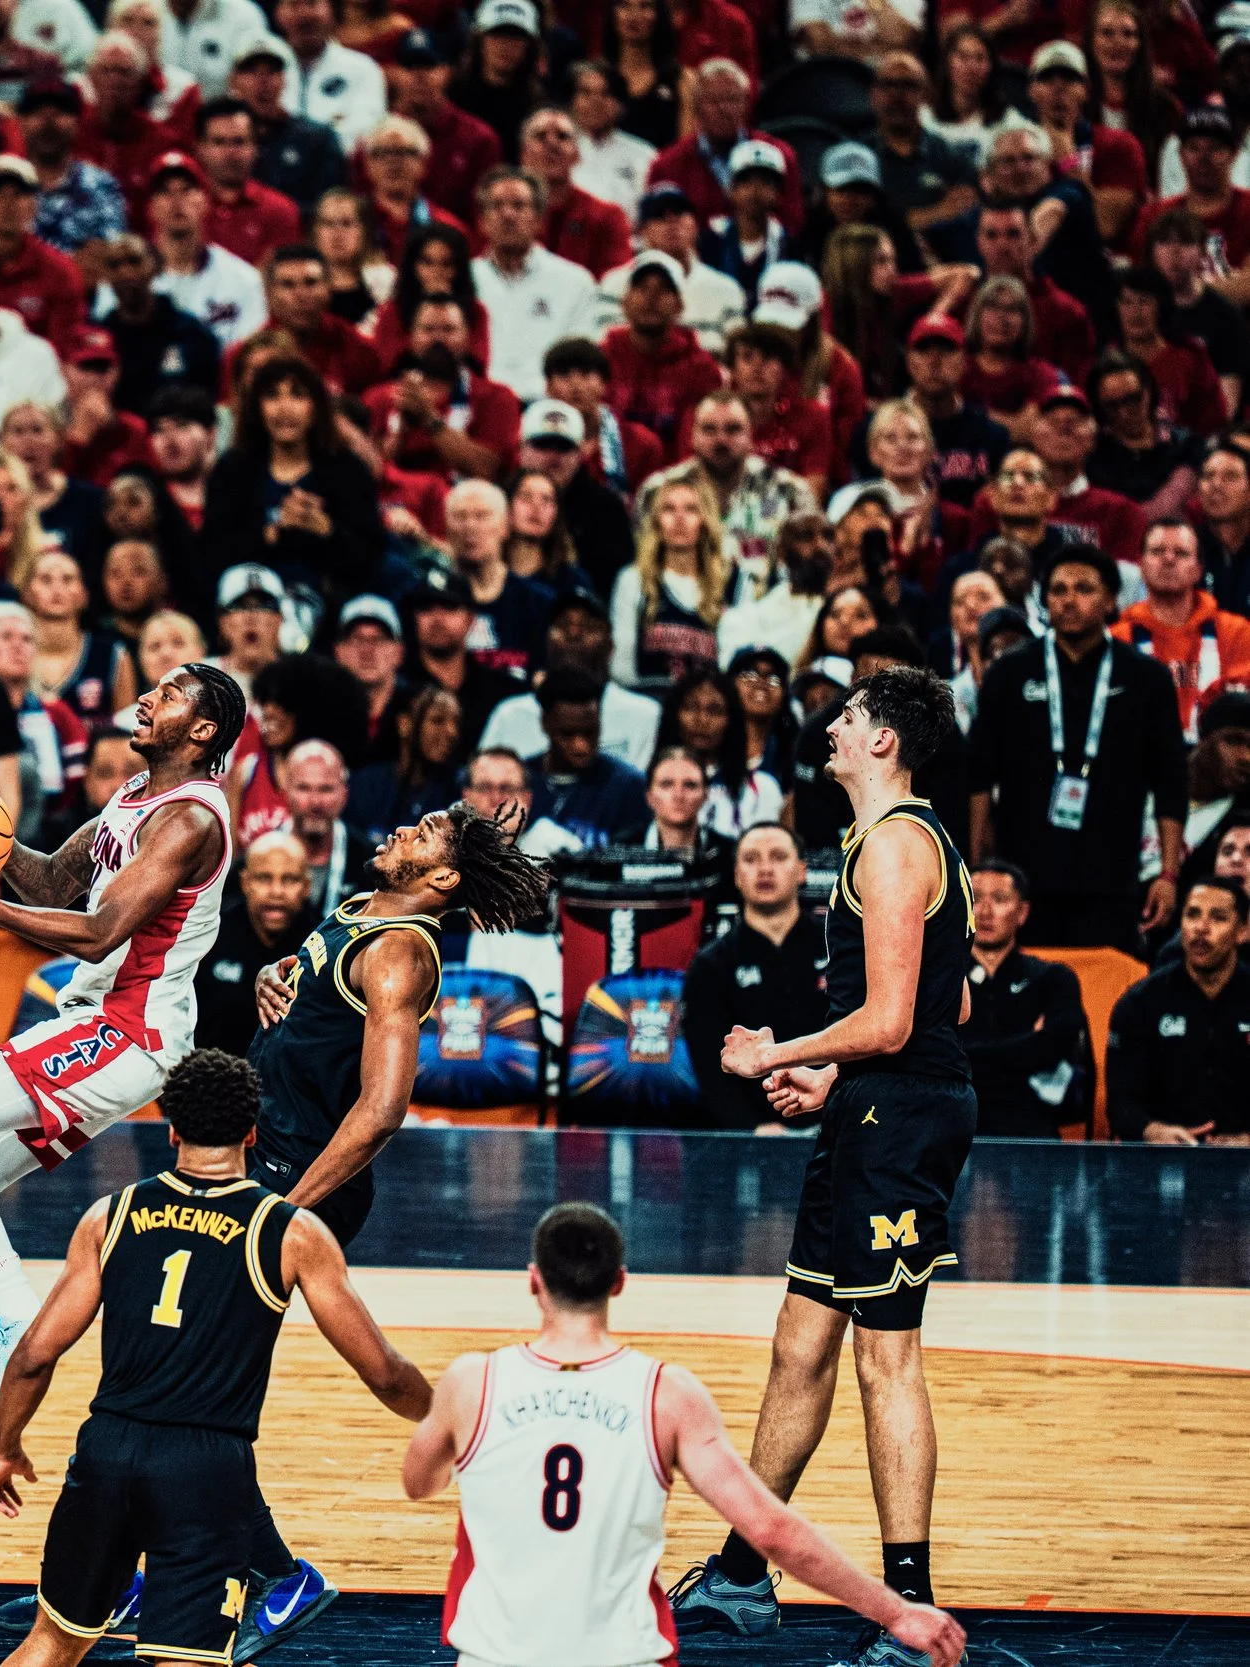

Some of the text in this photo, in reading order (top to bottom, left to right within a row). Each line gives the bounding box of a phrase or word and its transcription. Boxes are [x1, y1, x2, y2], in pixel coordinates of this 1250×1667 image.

[42, 1023, 125, 1079] CATS
[130, 1204, 246, 1245] McKENNEY
[870, 1209, 919, 1250] M
[151, 1249, 192, 1328] 1
[541, 1443, 584, 1532] 8
